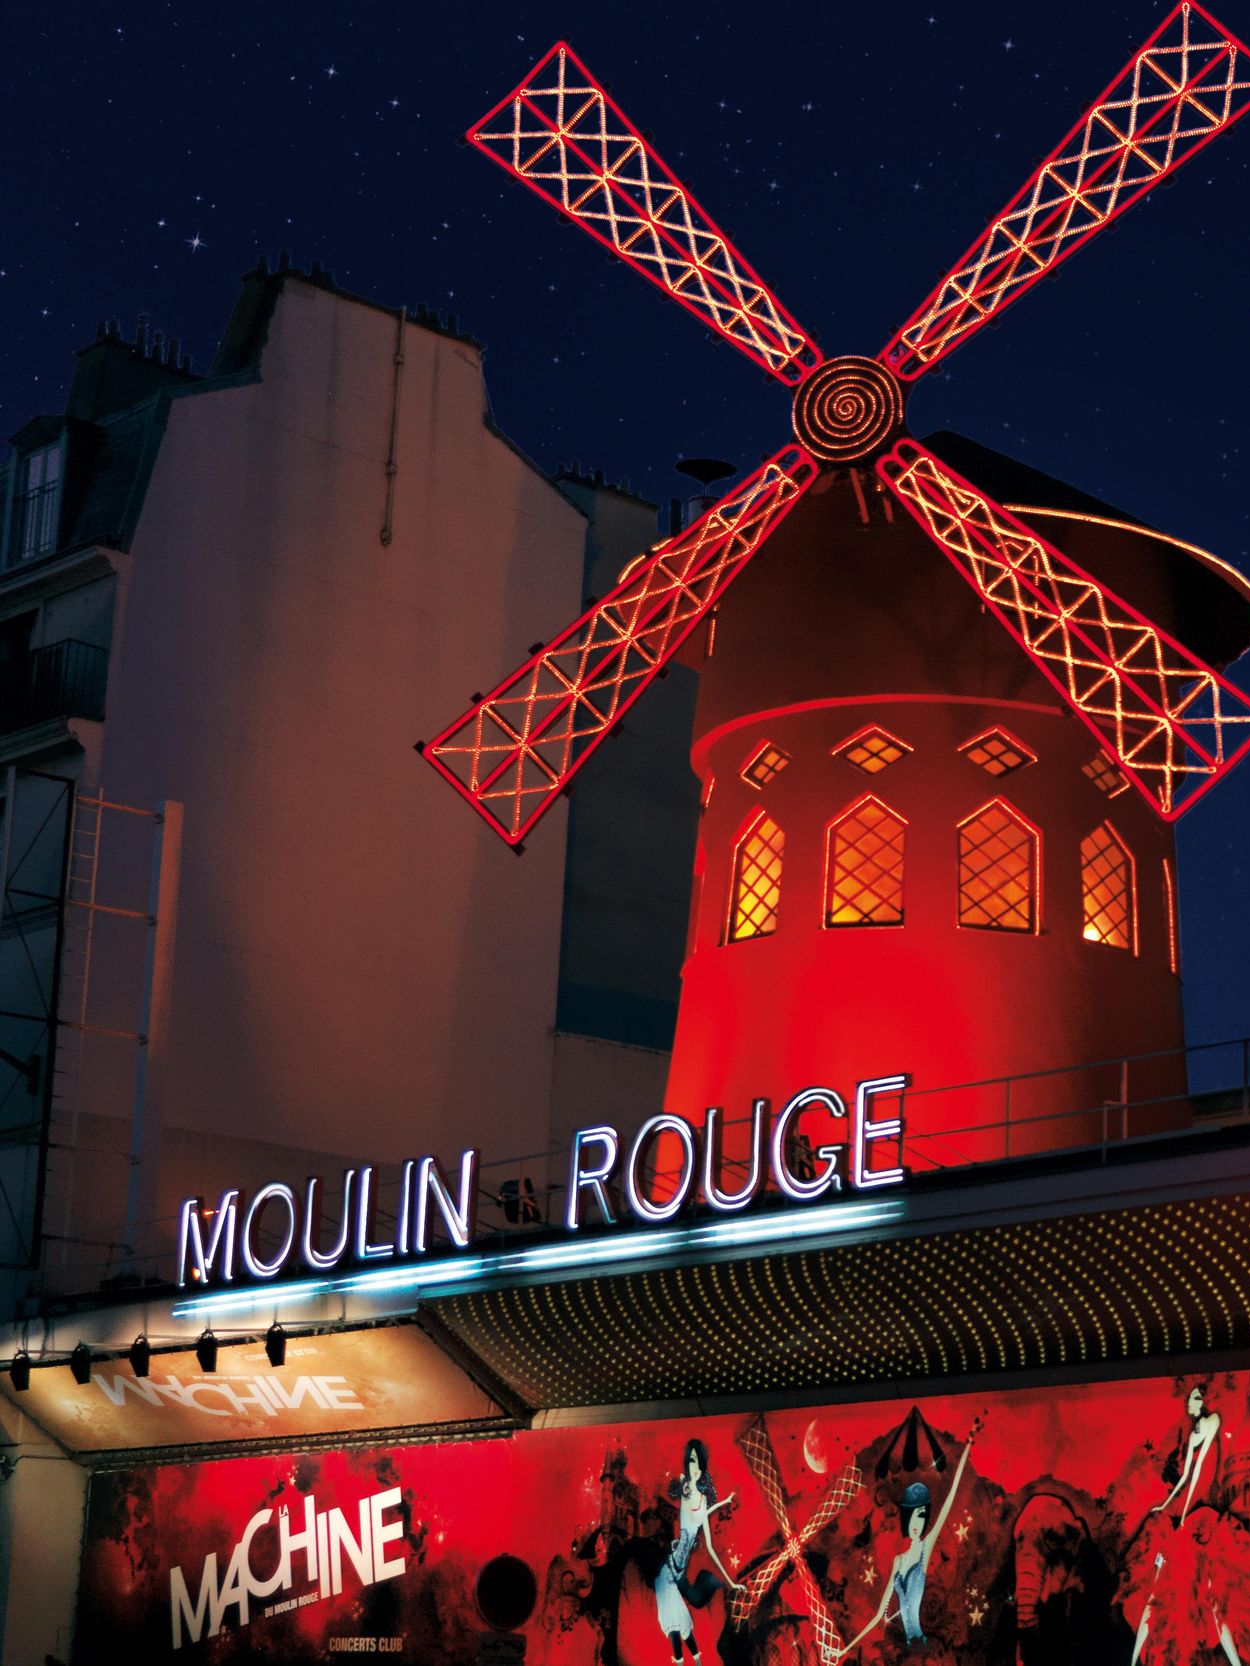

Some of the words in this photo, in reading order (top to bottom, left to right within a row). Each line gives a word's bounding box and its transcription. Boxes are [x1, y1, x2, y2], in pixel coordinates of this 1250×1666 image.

[178, 1147, 482, 1288] MOULIN
[565, 1073, 913, 1232] ROUGE
[278, 1503, 289, 1518] LA
[169, 1486, 406, 1650] MACHINE
[264, 1605, 276, 1618] DU
[275, 1599, 298, 1615] MOULIN
[299, 1592, 319, 1608] ROUGE
[329, 1637, 377, 1652] CONCERTS
[378, 1637, 404, 1652] CLUB
